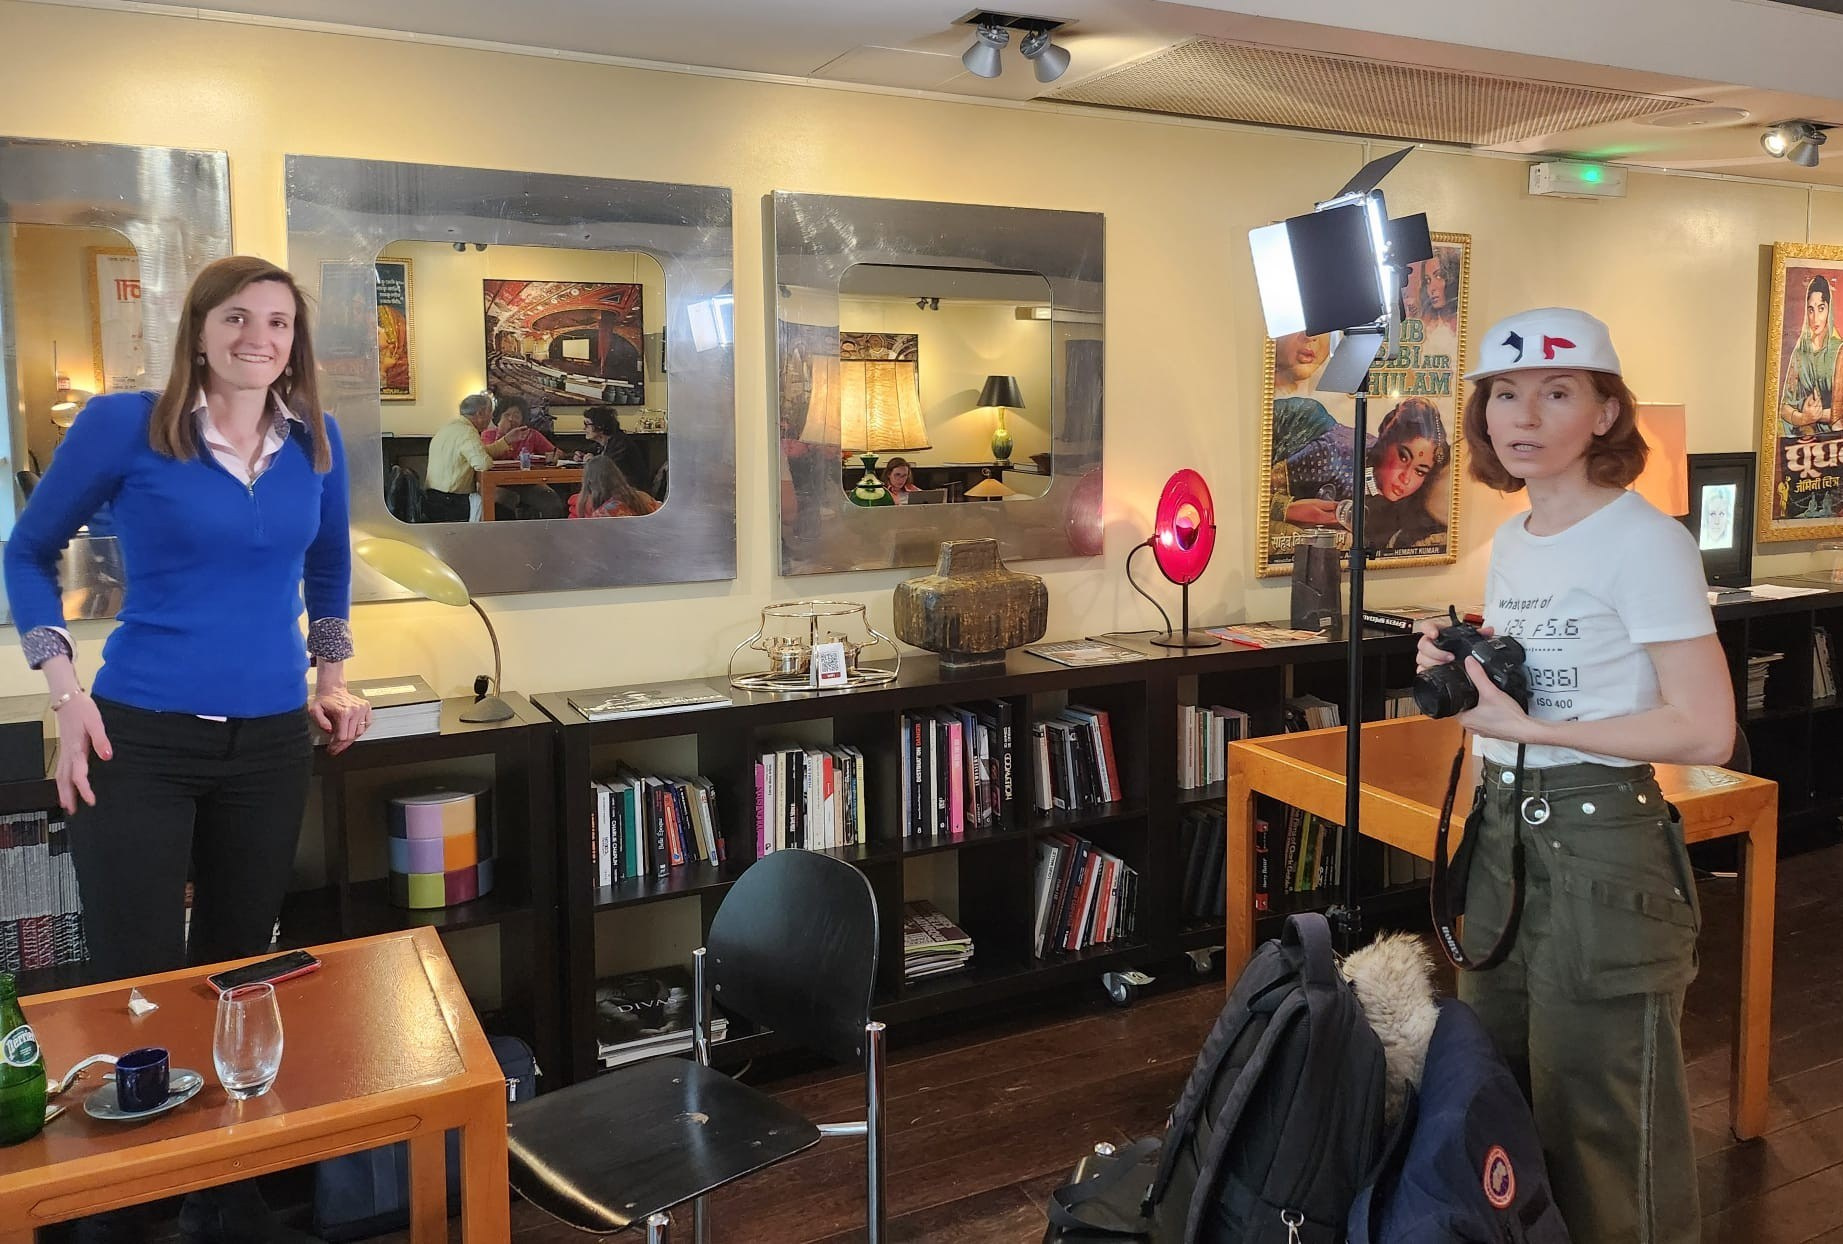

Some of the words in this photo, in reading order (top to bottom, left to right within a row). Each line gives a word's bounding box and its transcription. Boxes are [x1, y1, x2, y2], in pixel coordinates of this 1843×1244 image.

[1422, 354, 1450, 369] AUR
[1367, 371, 1451, 396] HULAM
[1520, 597, 1539, 613] part
[1540, 594, 1554, 609] of
[1536, 697, 1553, 707] ISO
[1554, 698, 1573, 709] 400
[1004, 752, 1012, 800] HOLLYWOOD
[1441, 926, 1463, 961] Canon
